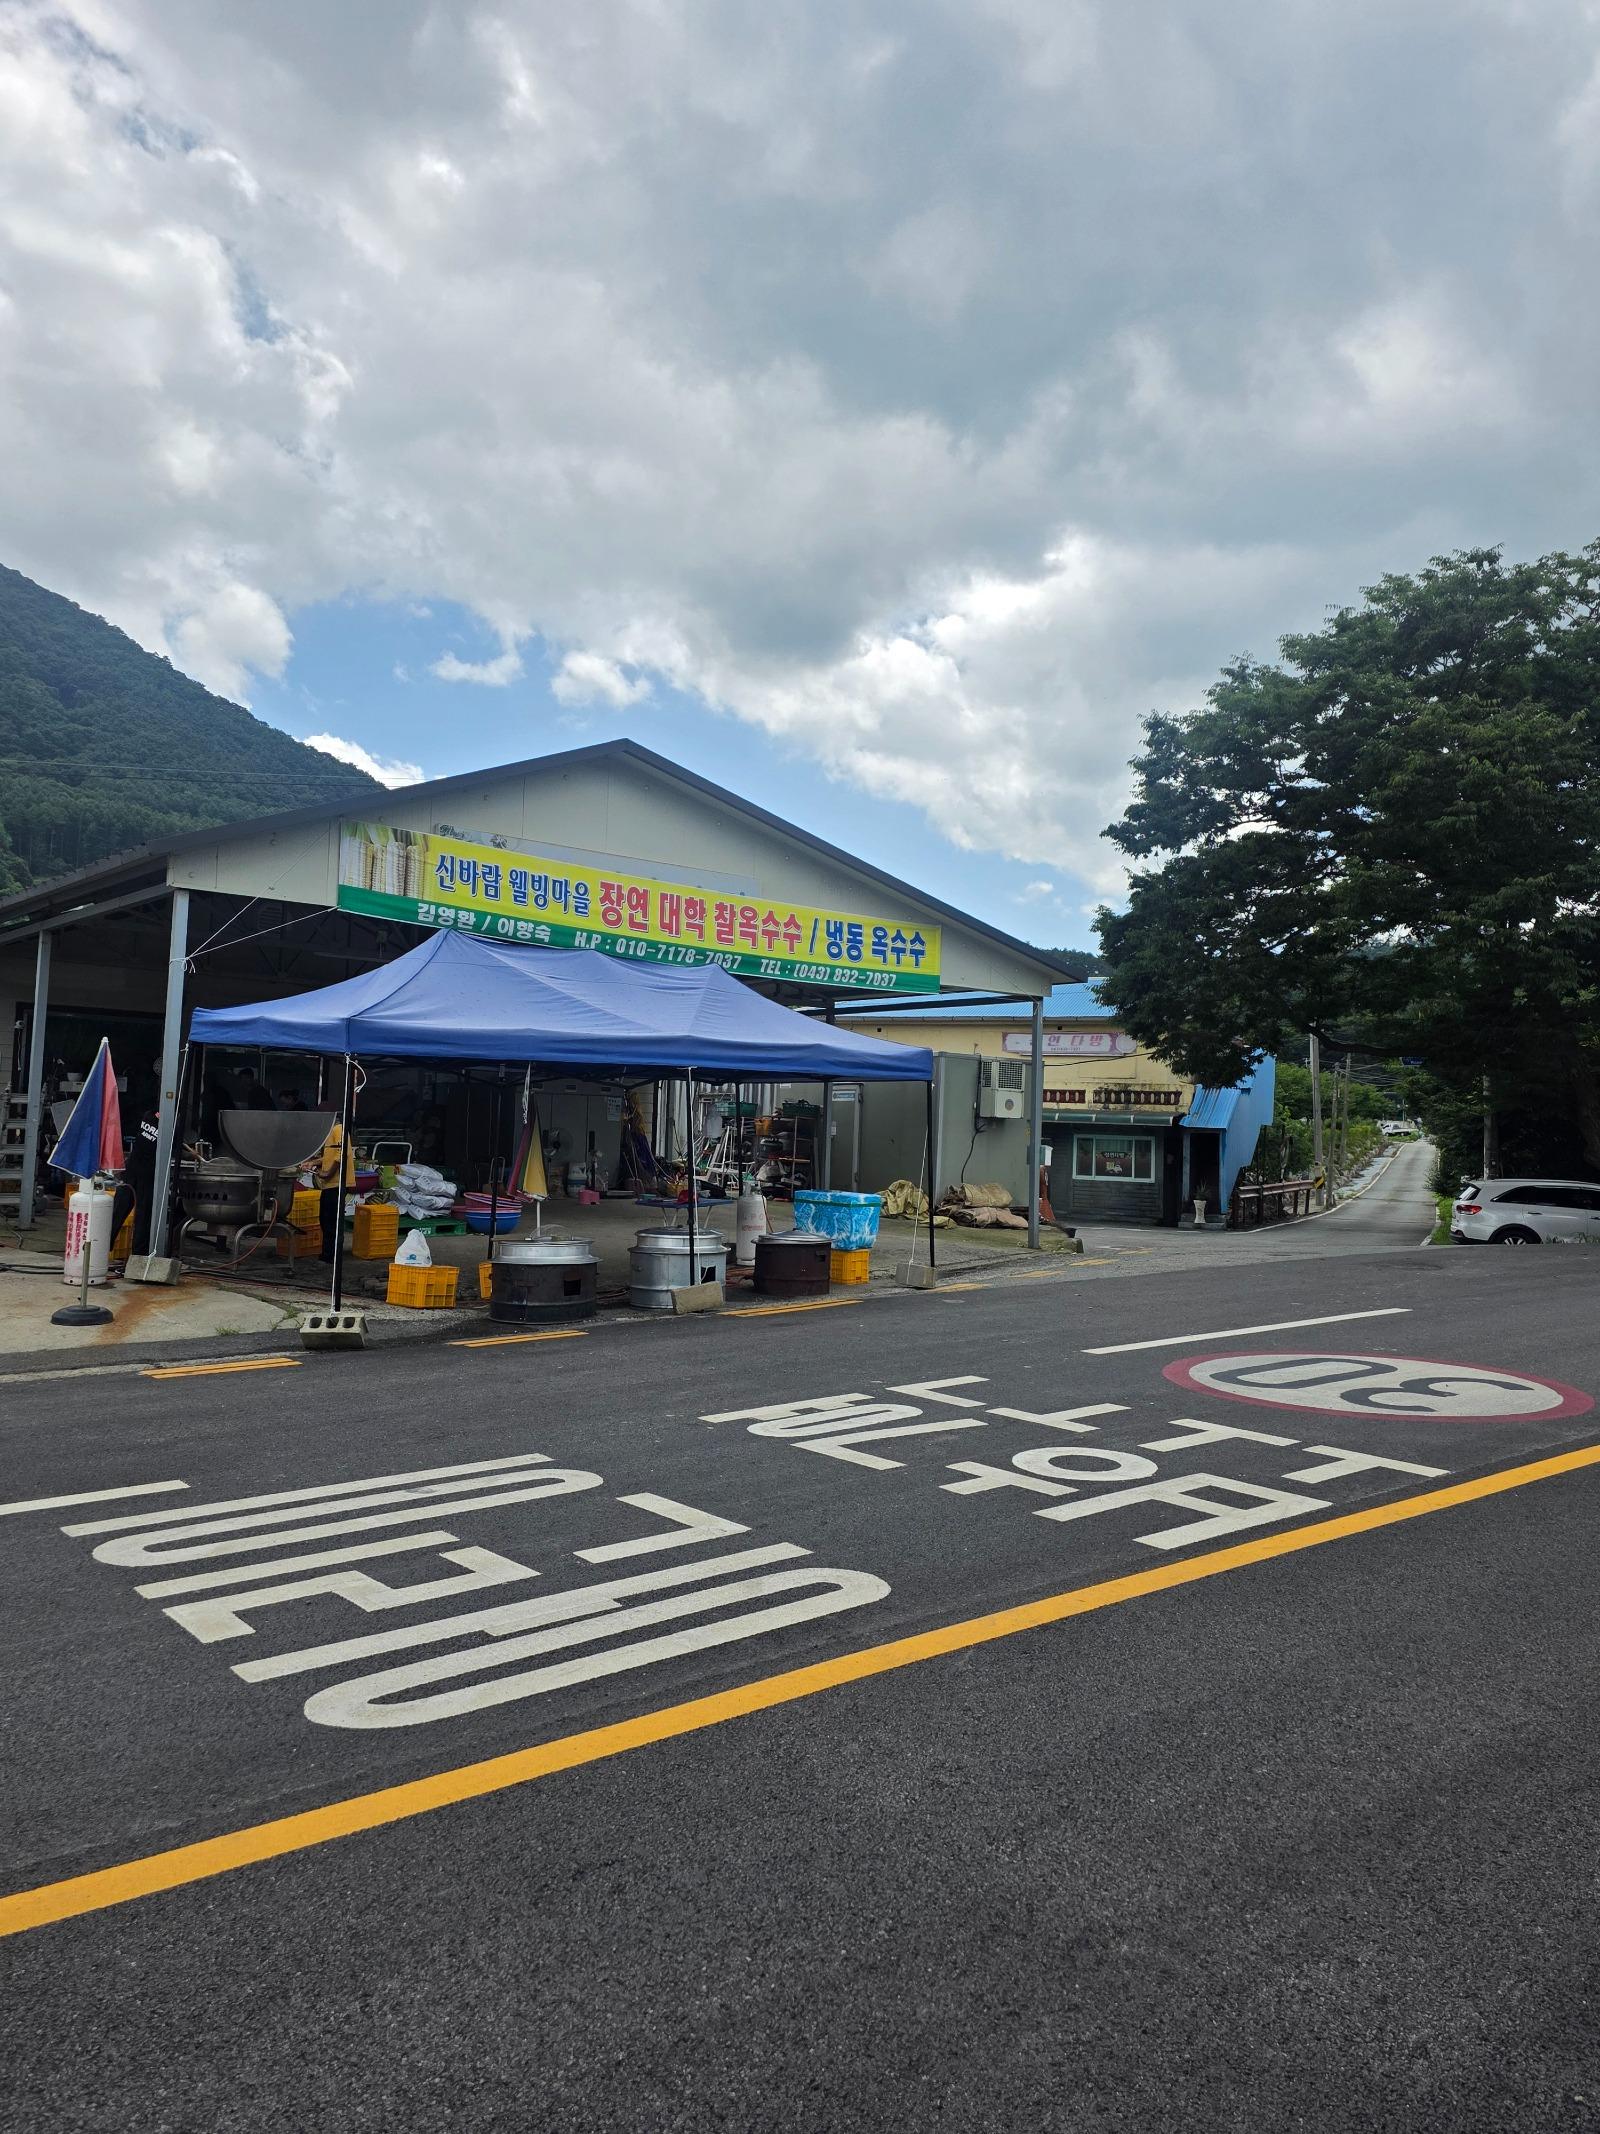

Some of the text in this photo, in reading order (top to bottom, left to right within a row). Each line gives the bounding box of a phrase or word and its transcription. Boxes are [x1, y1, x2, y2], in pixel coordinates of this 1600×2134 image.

[417, 902, 477, 930] 김영환
[497, 917, 551, 943] 이향숙
[436, 854, 502, 901] 신바람
[509, 868, 591, 917] 웰빙마을
[599, 880, 650, 933] 장연
[659, 892, 706, 942] 대학
[714, 901, 802, 954] 찰옥수수
[825, 919, 864, 963] 냉동
[871, 926, 926, 968] 옥수수
[760, 959, 782, 975] TEL
[833, 968, 897, 987] 832-7037
[141, 1130, 157, 1142] ARMY
[1208, 1357, 1536, 1413] 30
[700, 1375, 1448, 1550] 보호구역
[61, 1452, 892, 1729] 어린이
